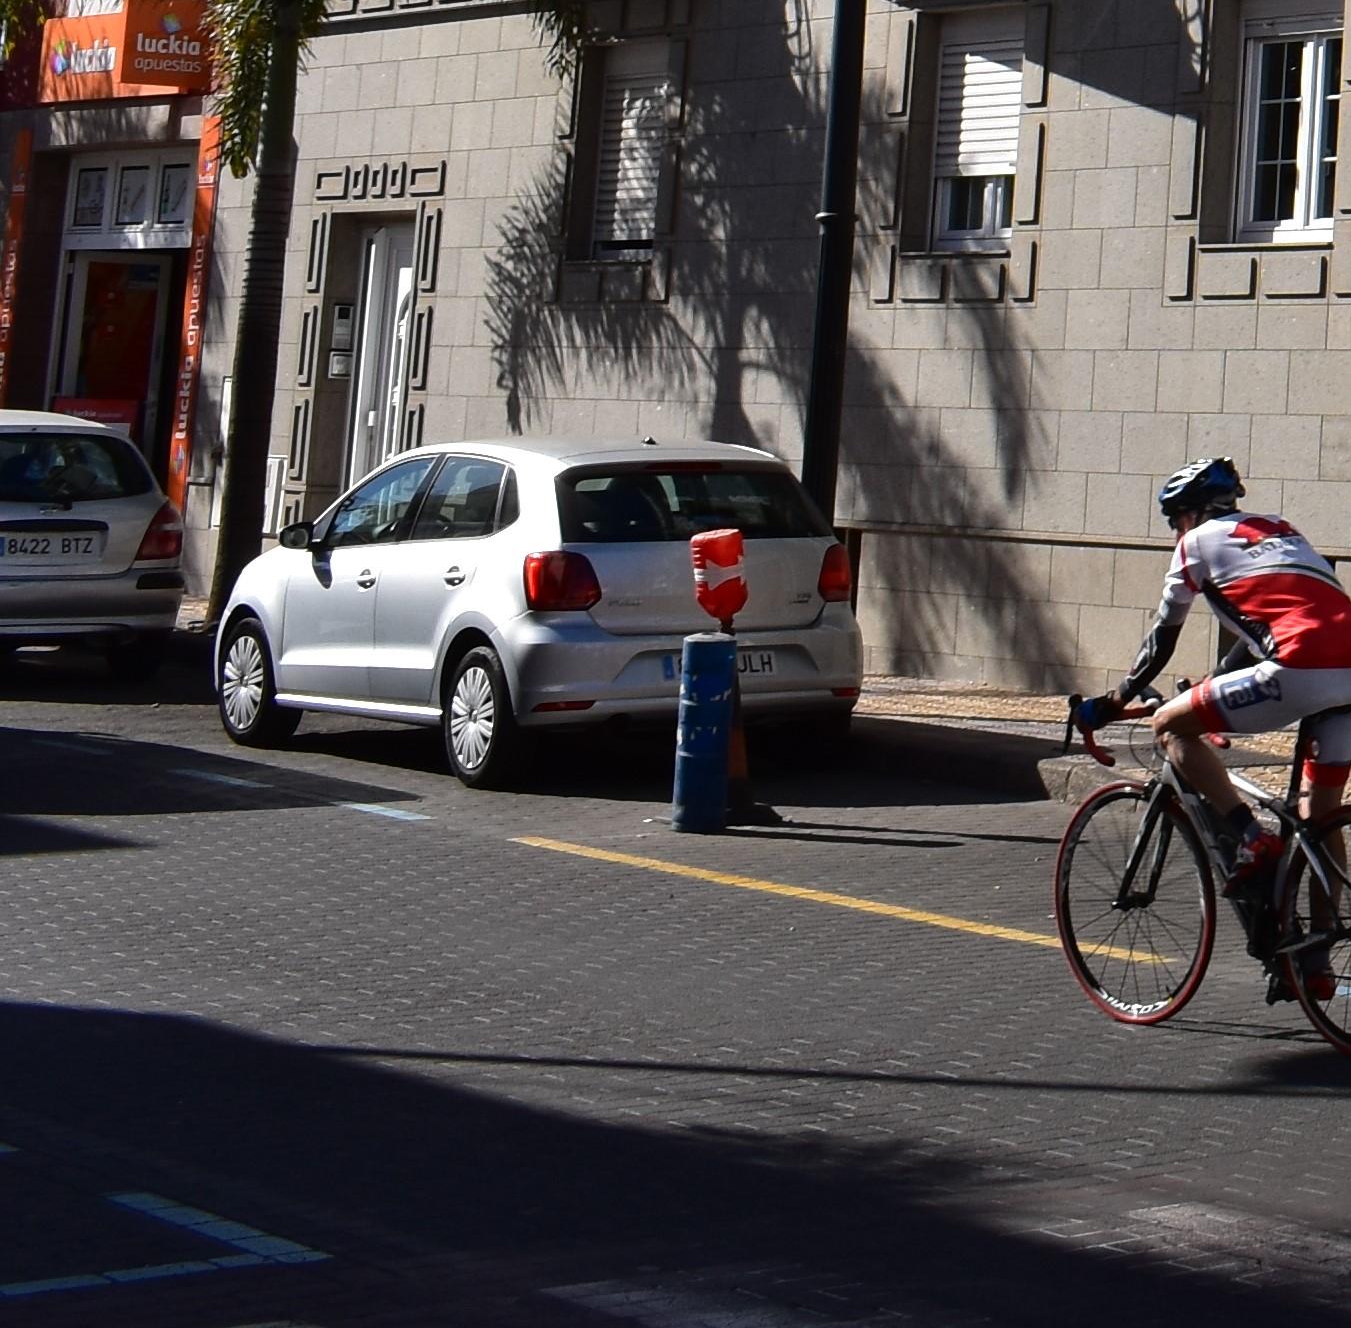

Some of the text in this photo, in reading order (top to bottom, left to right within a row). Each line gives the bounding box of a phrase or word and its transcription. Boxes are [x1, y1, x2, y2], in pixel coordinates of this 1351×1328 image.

[136, 33, 201, 56] luckia
[134, 56, 202, 73] apuestas
[175, 352, 195, 440] luckia
[7, 537, 93, 555] 8422 BTZ
[737, 653, 774, 673] JLH
